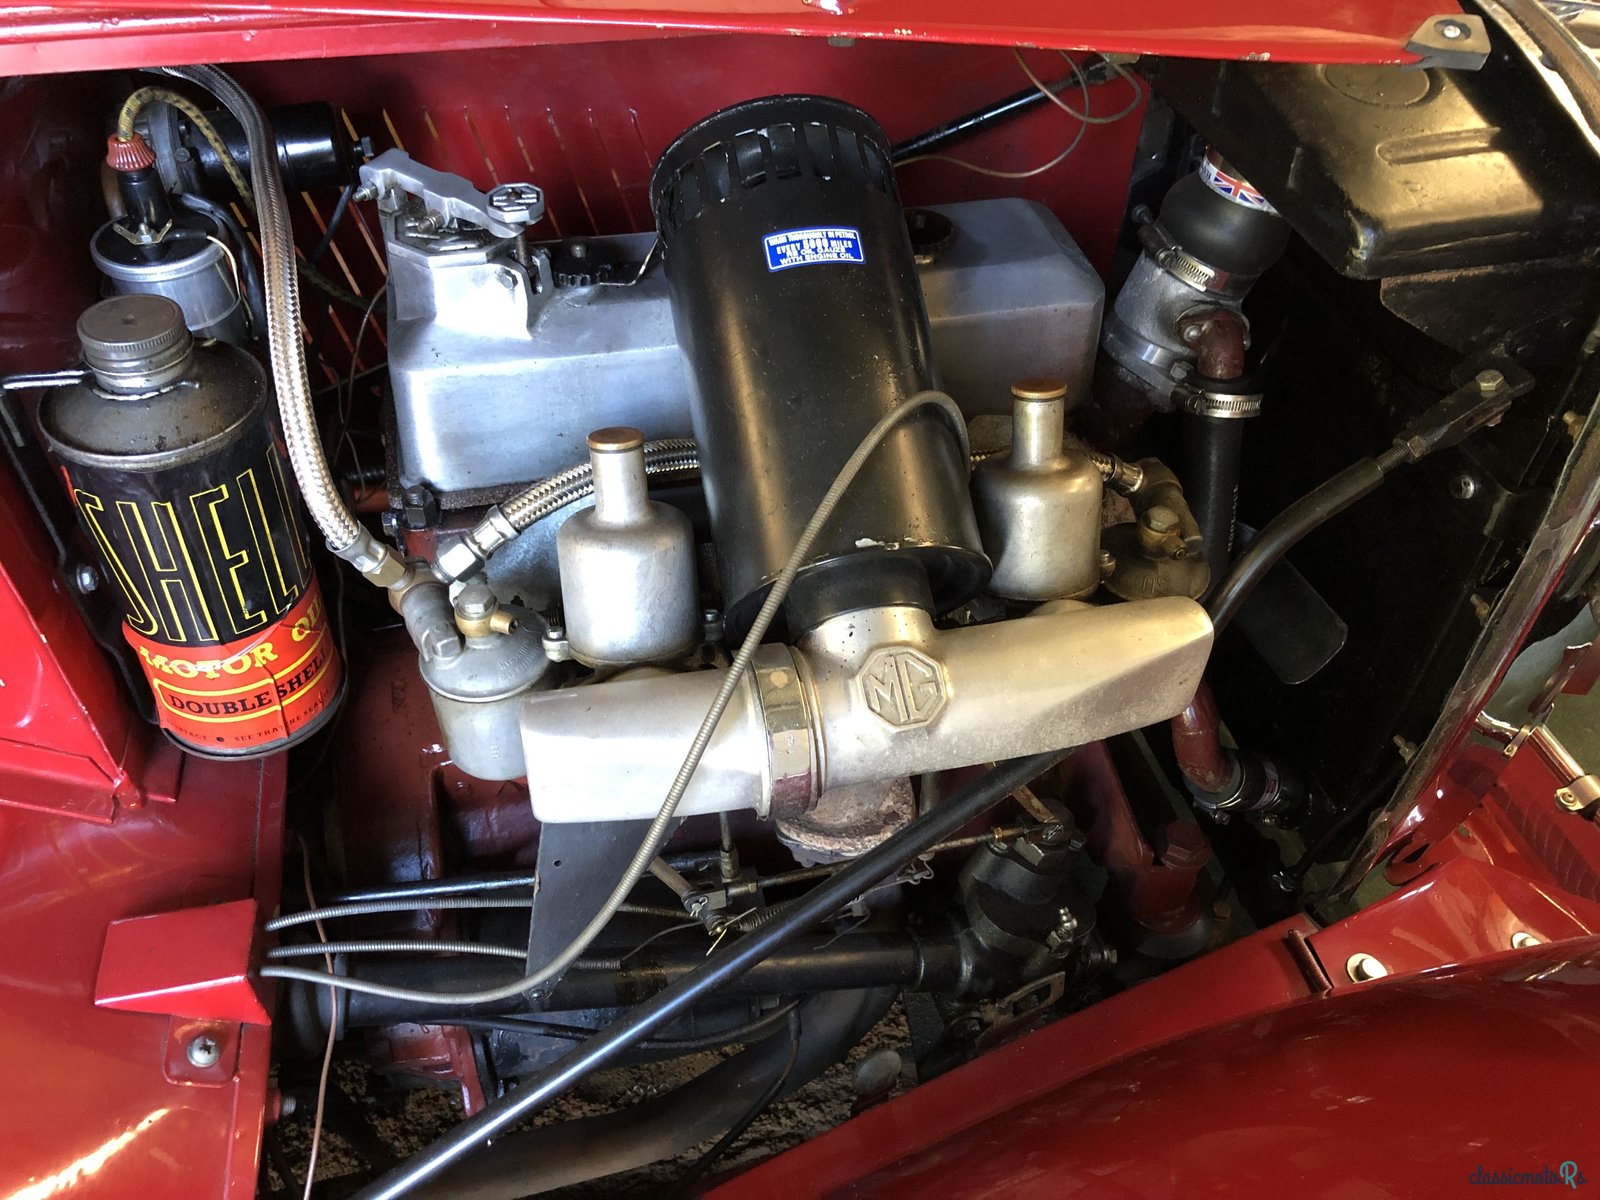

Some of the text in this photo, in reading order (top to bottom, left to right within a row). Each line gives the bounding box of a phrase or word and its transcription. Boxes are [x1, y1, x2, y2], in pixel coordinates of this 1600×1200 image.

[776, 243, 801, 254] EVERY
[830, 240, 853, 249] MILES
[780, 252, 854, 265] WITH ENGINE OIL
[817, 246, 846, 254] GAUZE
[74, 441, 314, 642] SHELL
[138, 644, 279, 680] MOTOR
[867, 653, 940, 723] MG
[168, 690, 273, 715] DOUBLE
